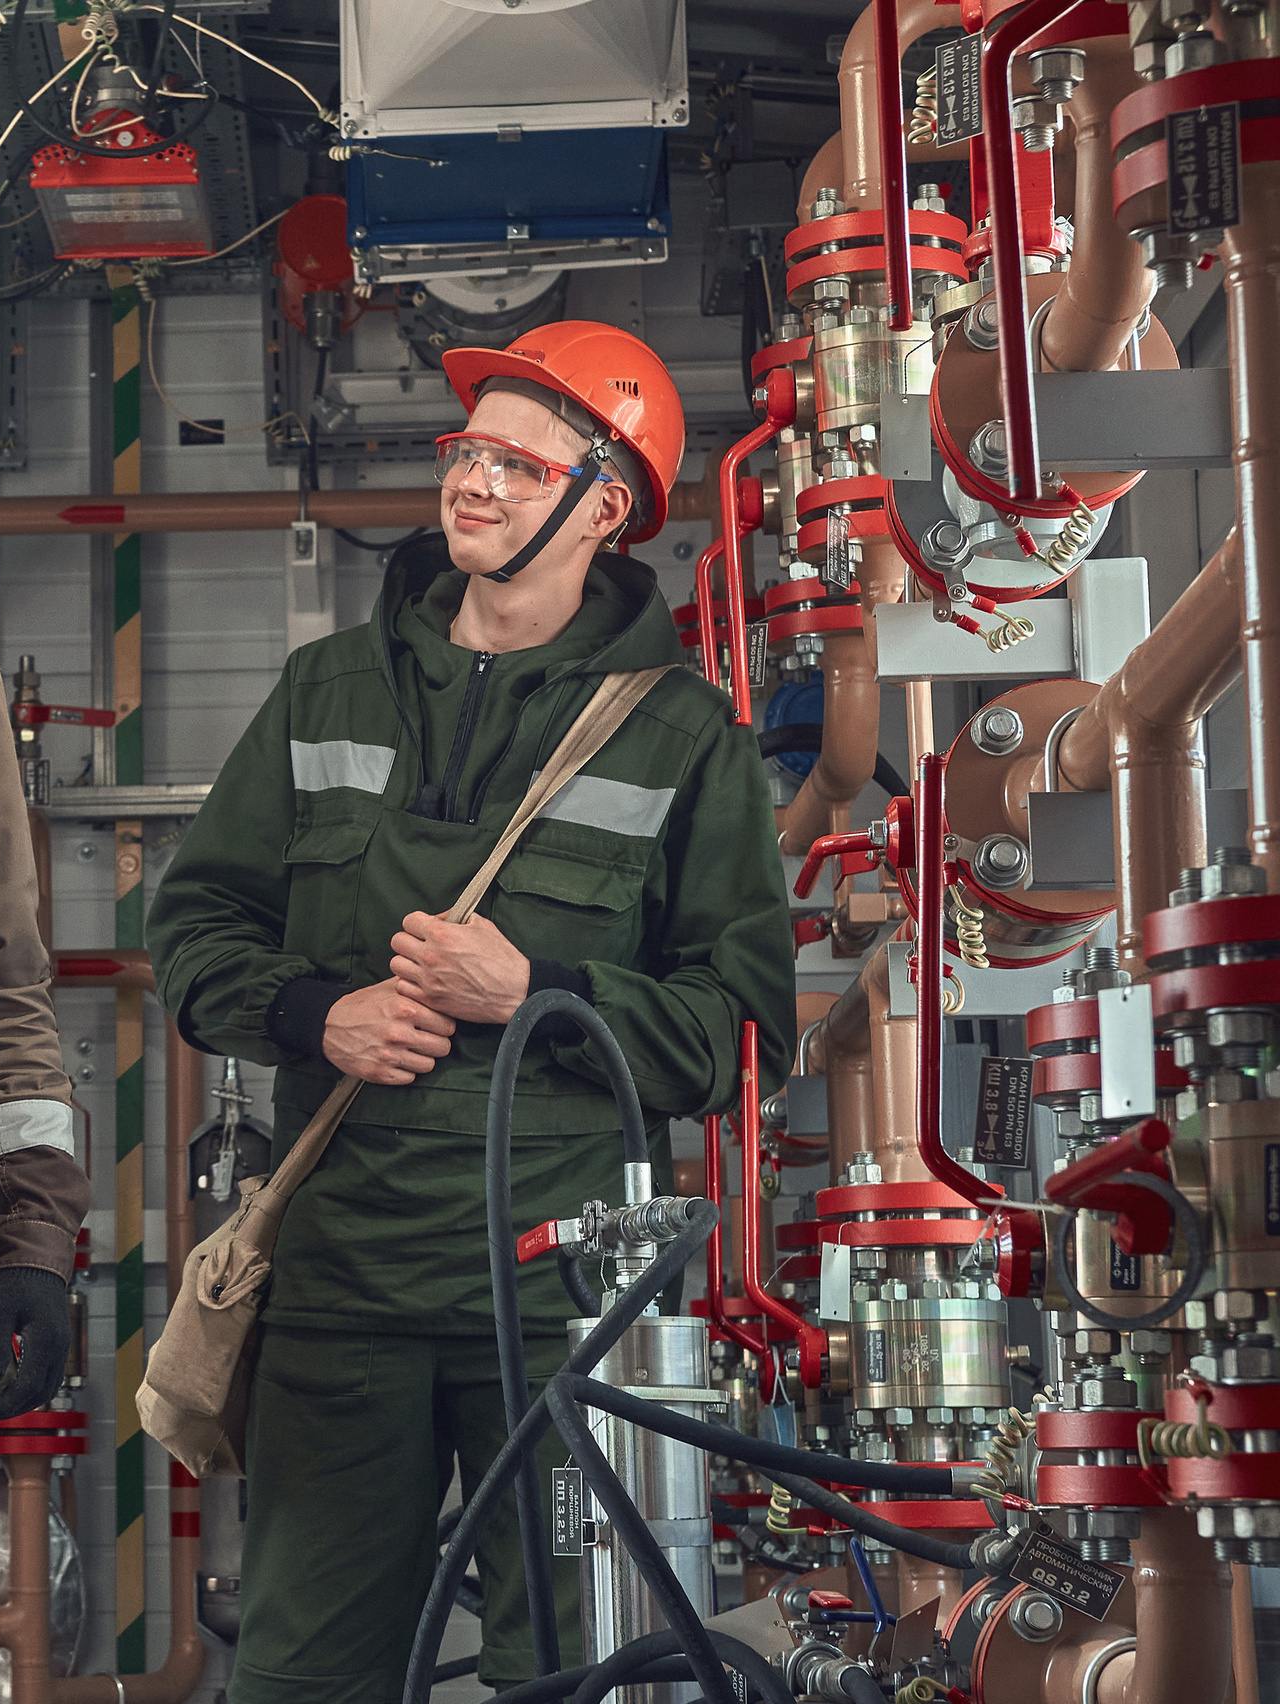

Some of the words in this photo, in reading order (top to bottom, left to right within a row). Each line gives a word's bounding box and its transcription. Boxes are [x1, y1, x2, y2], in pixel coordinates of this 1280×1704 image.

[943, 48, 955, 66] КШ
[962, 54, 969, 71] DN
[943, 69, 955, 94] 3.13
[963, 73, 969, 87] 50
[963, 90, 969, 105] PN
[963, 107, 969, 121] 63
[988, 1064, 1002, 1085] КШ
[1019, 1067, 1028, 1097] КРАН
[1009, 1077, 1017, 1093] DN
[985, 1089, 999, 1110] 3.8
[1008, 1097, 1015, 1110] 50
[1006, 1114, 1014, 1129] PN
[1014, 1101, 1025, 1159] ШАРОВОЙ
[1004, 1133, 1012, 1147] 63
[558, 1480, 564, 1500] ПП
[1029, 1548, 1113, 1594] АВТОМАТИЧЕСКИЙ
[1037, 1541, 1114, 1584] ПРОБООТБОРНИК
[1032, 1567, 1057, 1586] QS
[1060, 1582, 1090, 1604] 3.2
